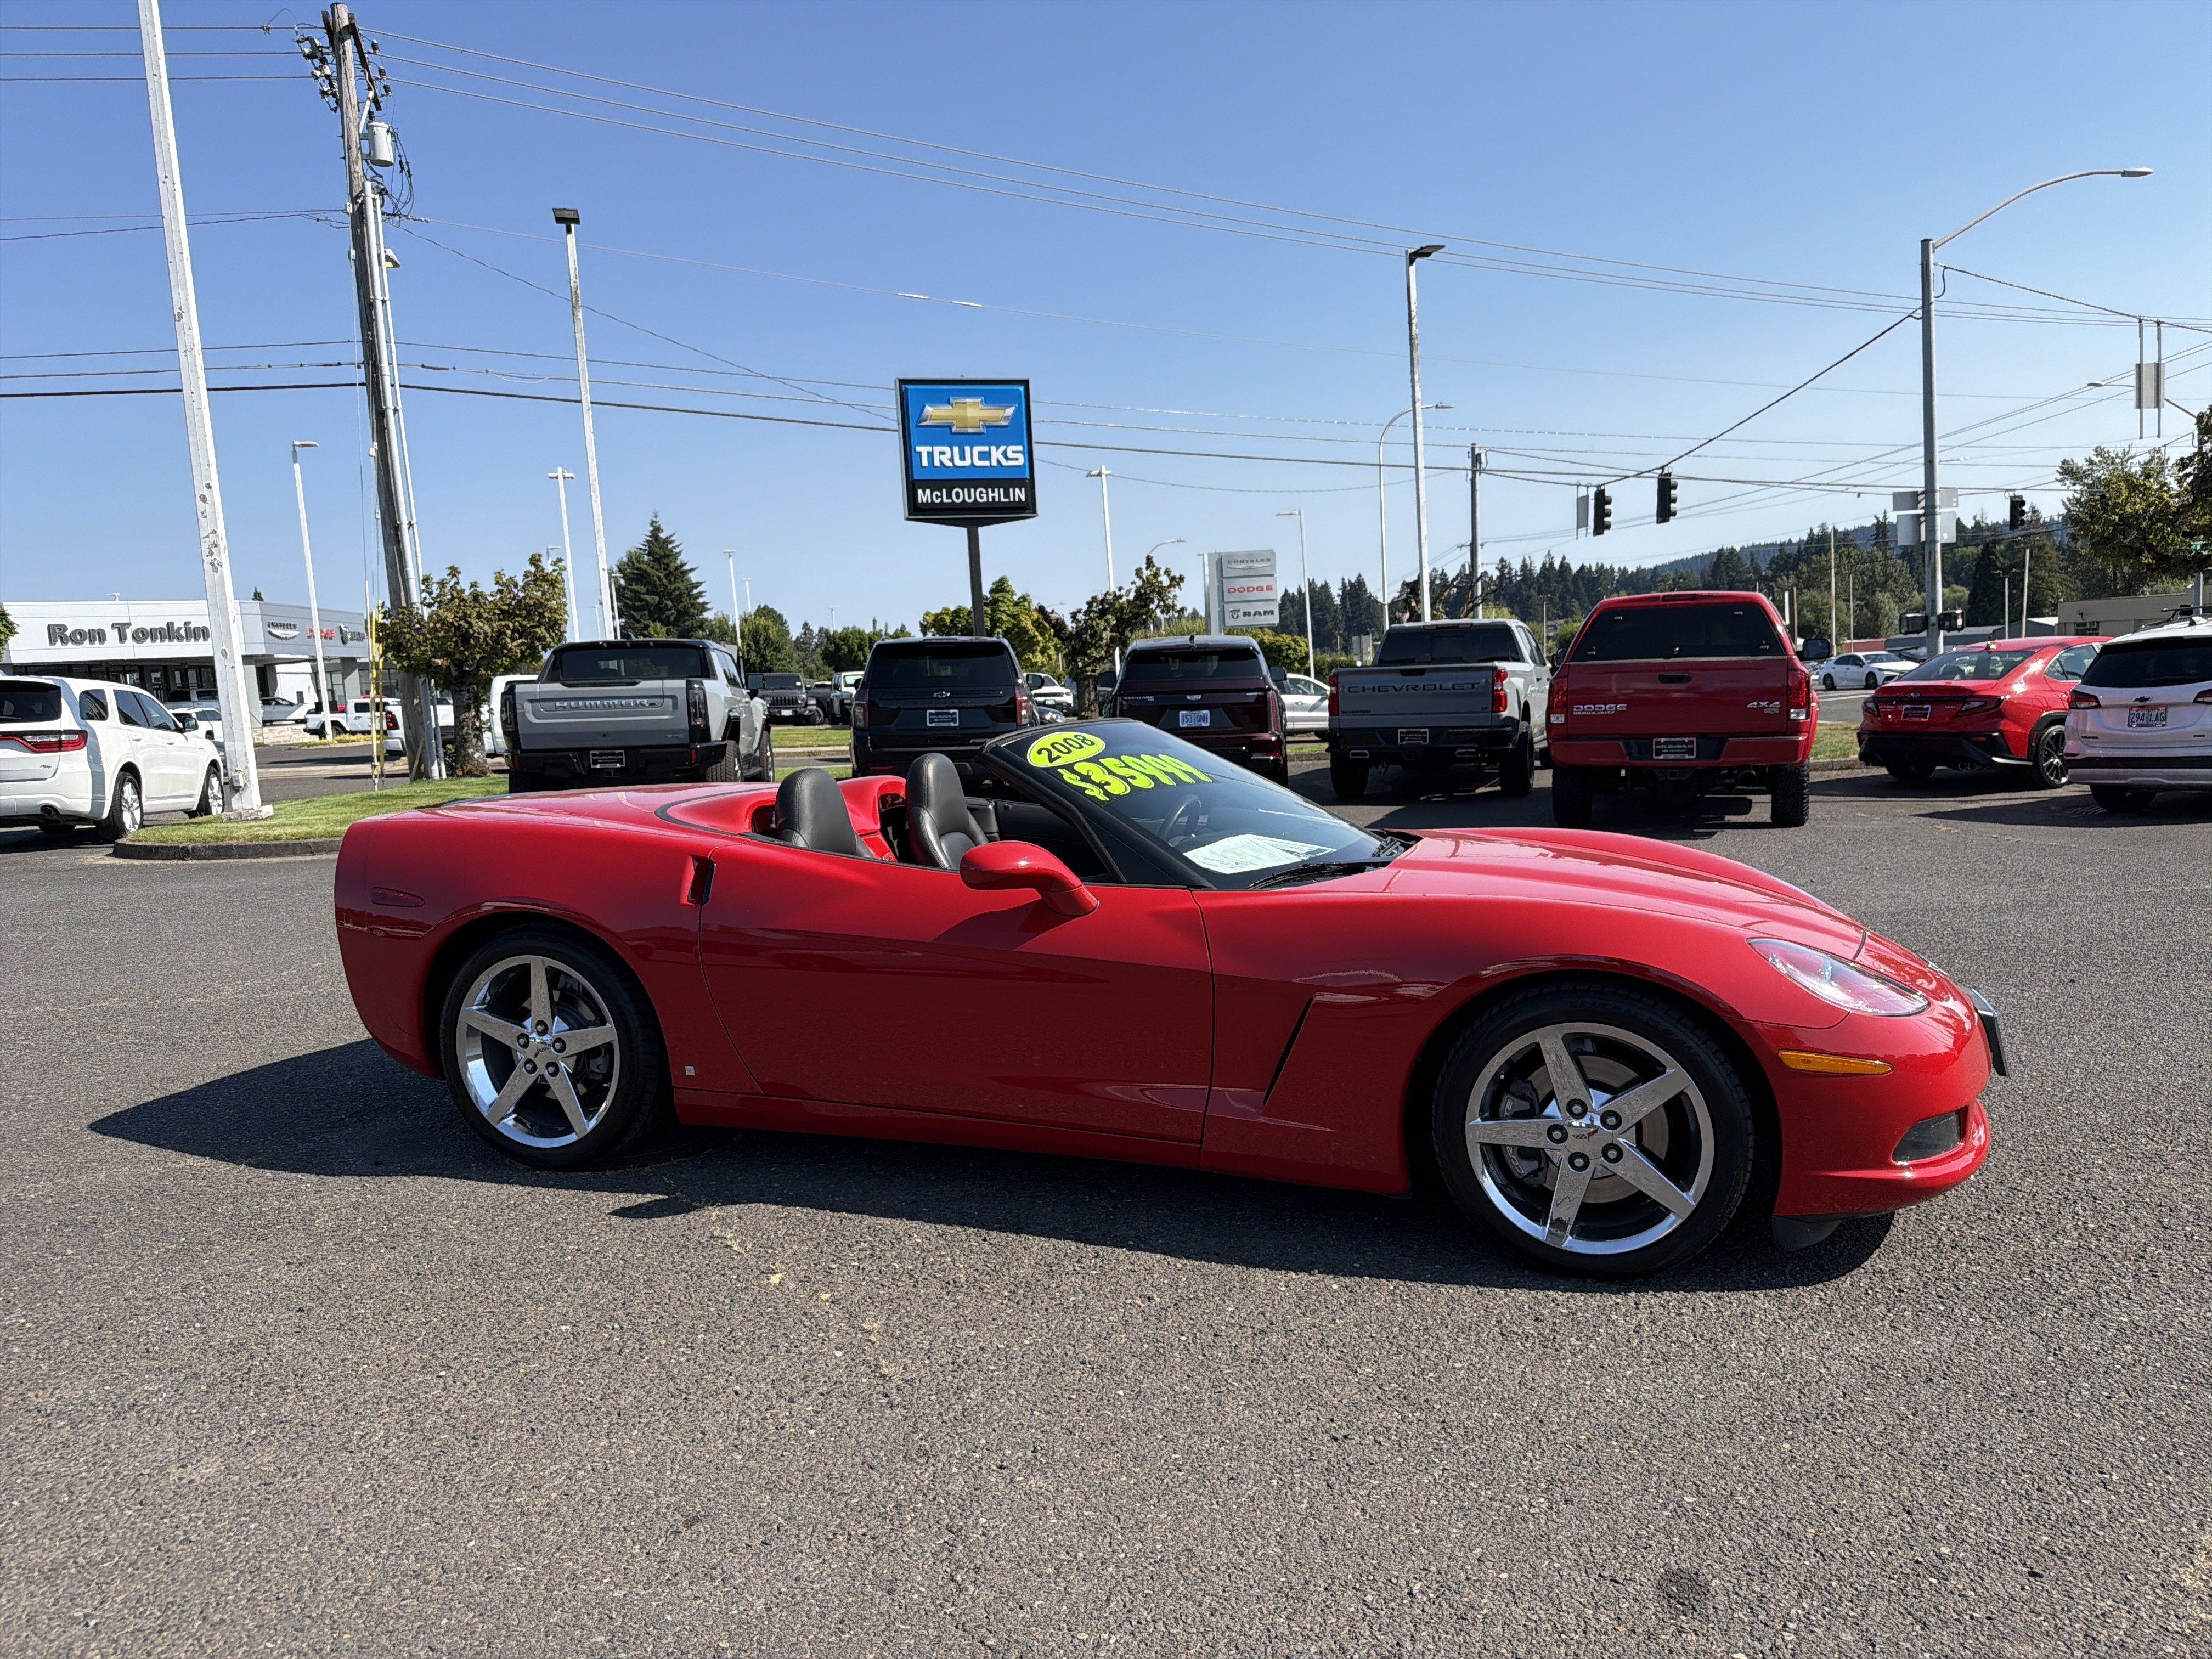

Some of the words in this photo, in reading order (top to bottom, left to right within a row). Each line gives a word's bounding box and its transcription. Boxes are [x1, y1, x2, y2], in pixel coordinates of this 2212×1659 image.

[916, 445, 1024, 467] TRUCKS
[917, 487, 1026, 504] McLOUGHLIN
[1228, 585, 1273, 594] DODGE
[47, 623, 107, 646] Ron
[111, 620, 211, 645] Tonkin
[1348, 682, 1480, 693] CHEVROLET
[554, 698, 650, 710] HUMMER
[2131, 713, 2145, 723] 294
[2149, 712, 2165, 723] LAG
[1036, 734, 1096, 764] 2008
[1057, 754, 1213, 802] $35999
